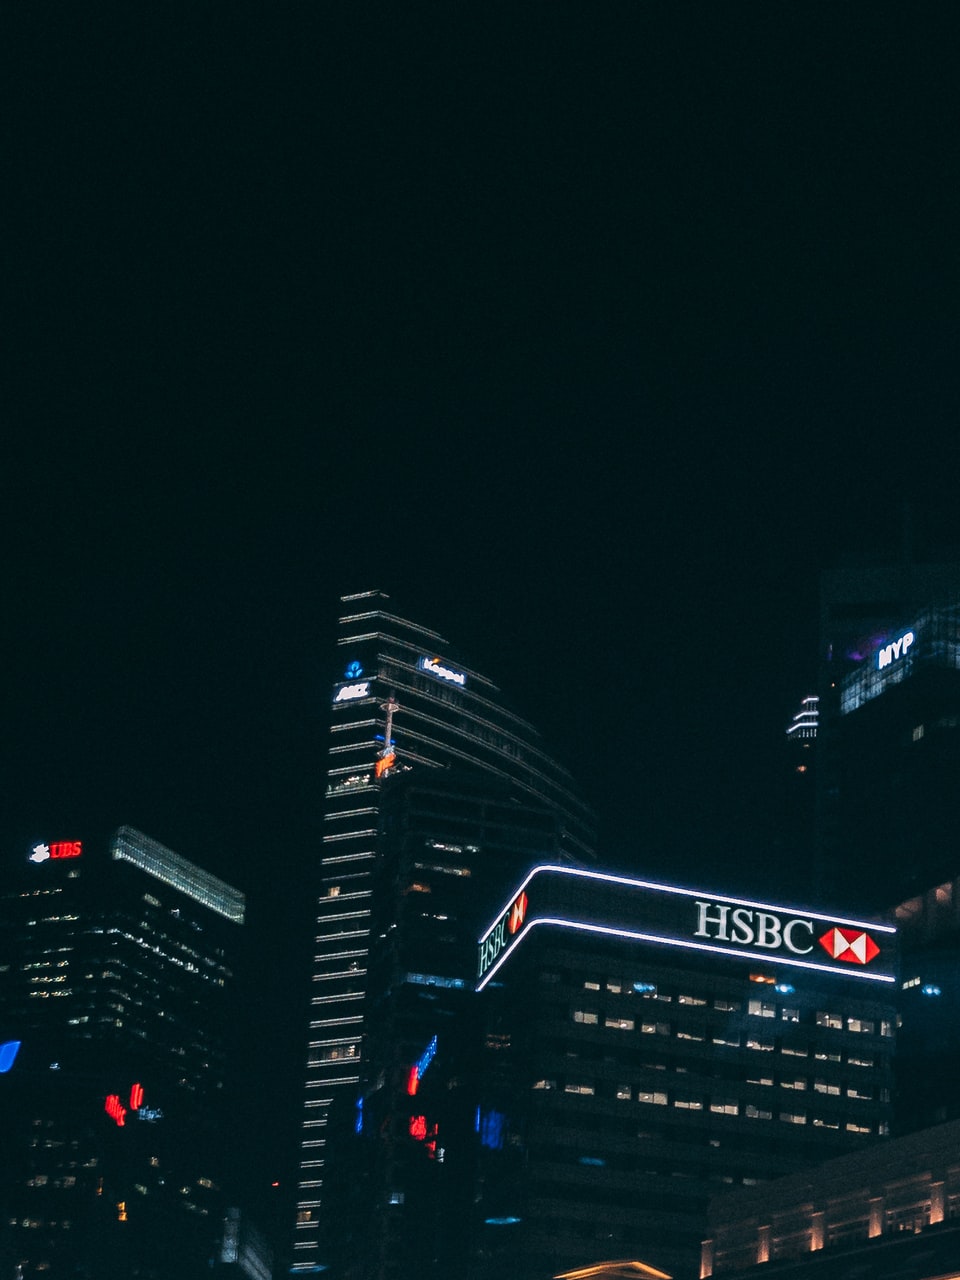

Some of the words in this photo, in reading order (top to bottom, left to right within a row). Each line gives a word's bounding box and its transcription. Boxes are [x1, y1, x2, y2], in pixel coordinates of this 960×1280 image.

[879, 632, 914, 669] MYP
[50, 841, 82, 858] UBS
[479, 911, 510, 978] HSBC
[694, 901, 813, 954] HSBC
